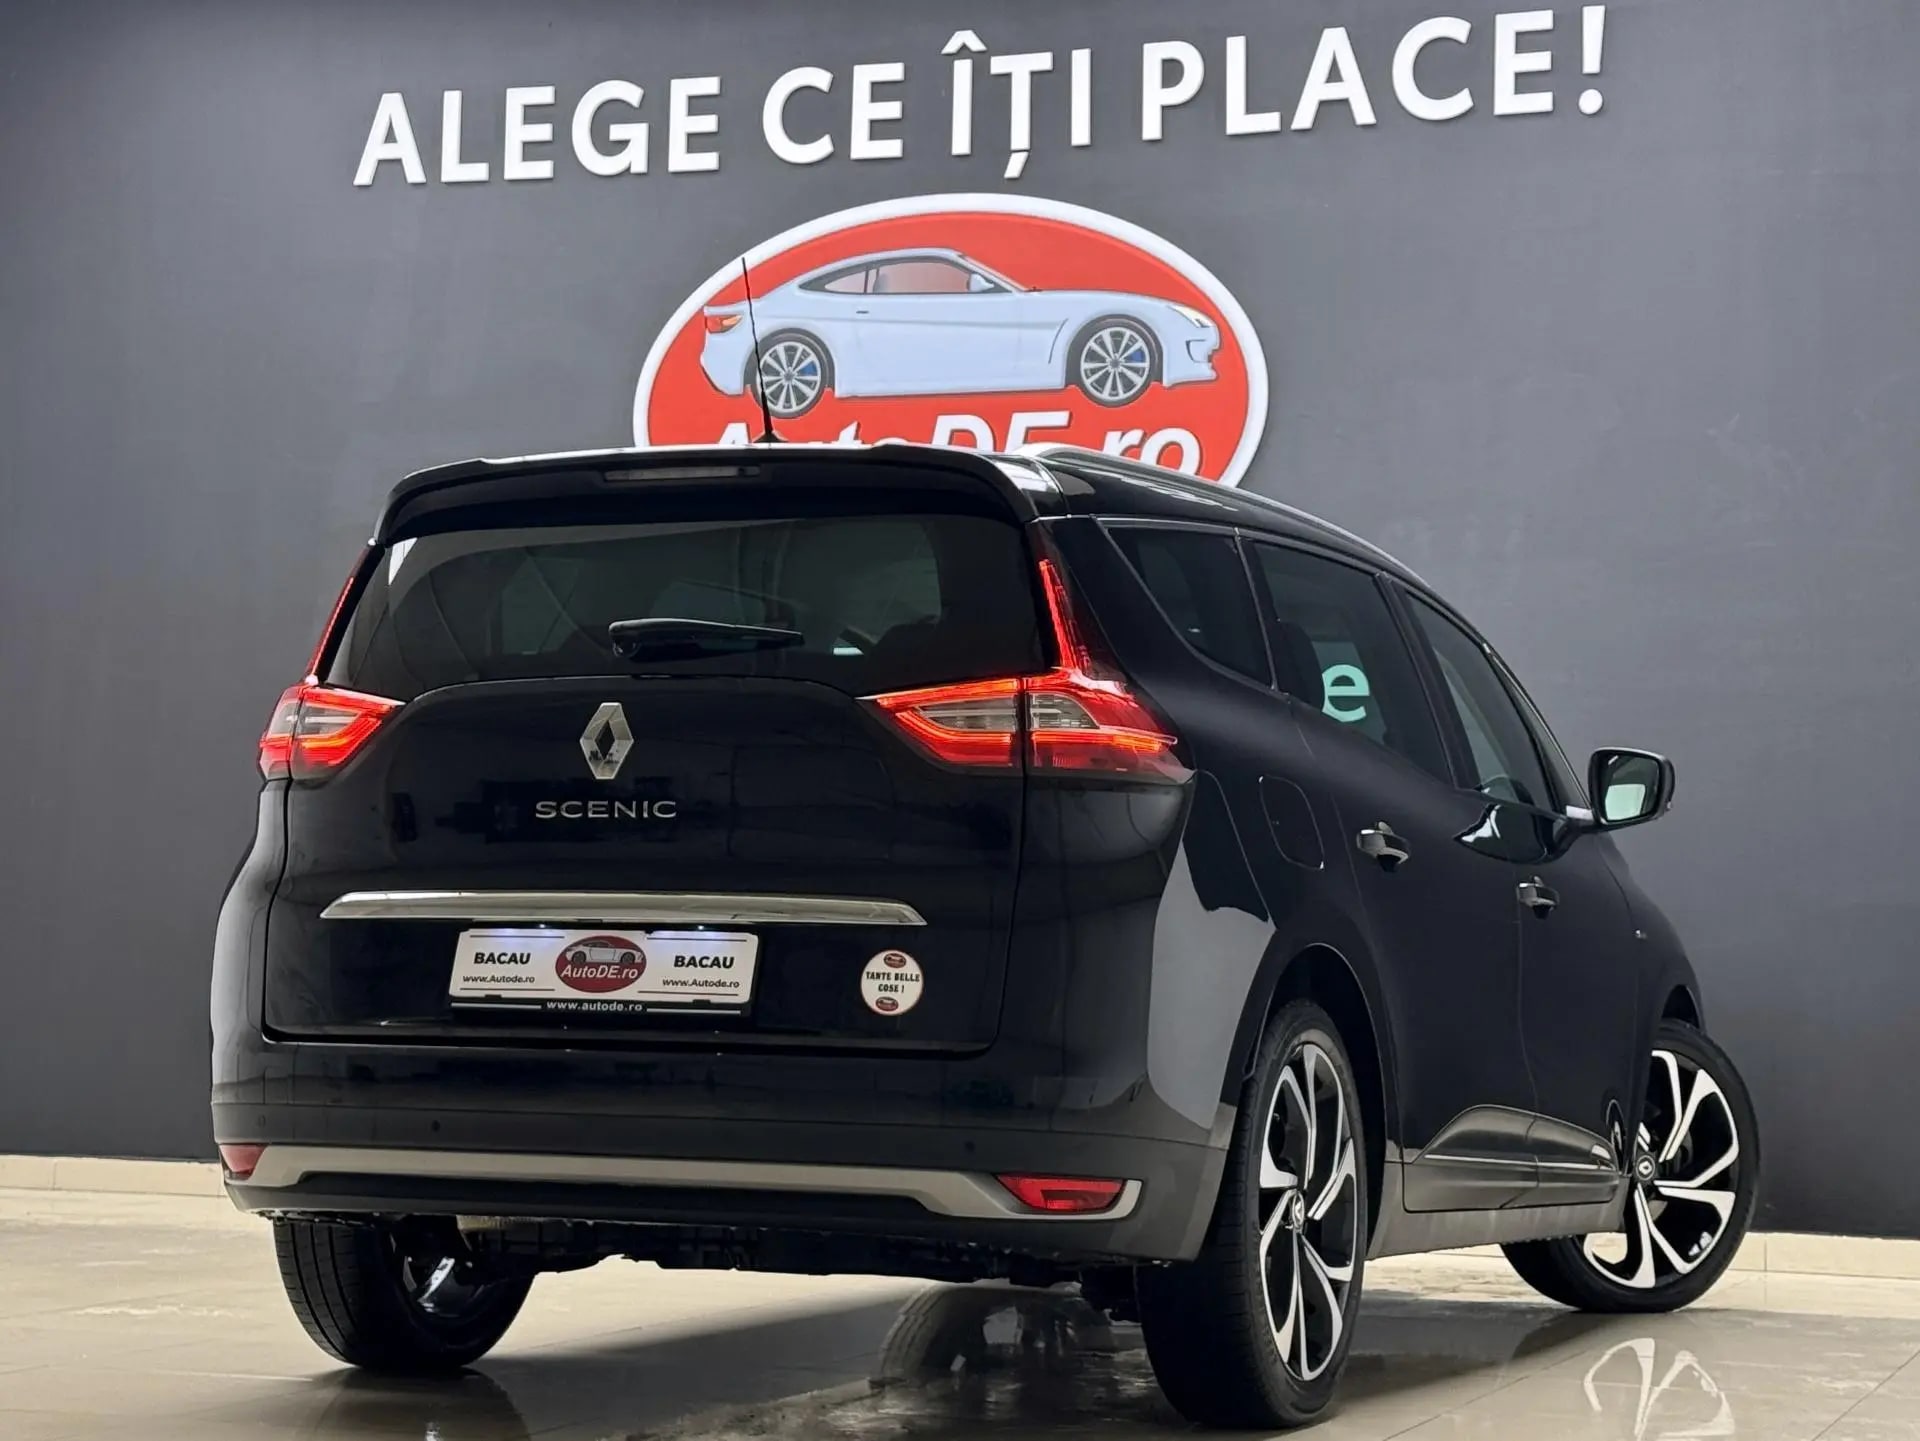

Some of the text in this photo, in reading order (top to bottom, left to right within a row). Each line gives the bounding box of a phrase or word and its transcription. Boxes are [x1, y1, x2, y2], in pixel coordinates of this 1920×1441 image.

[353, 5, 1605, 187] ALEGE CE ÎȚI PLACE!
[535, 800, 677, 819] SCENIC
[473, 952, 531, 965] BACAU
[673, 955, 735, 969] BACAU
[560, 964, 639, 979] AutoDE.ro
[462, 974, 536, 984] www.Autode.ro
[662, 977, 740, 989] www.Autode.ro
[546, 1001, 643, 1012] www.autode.ro
